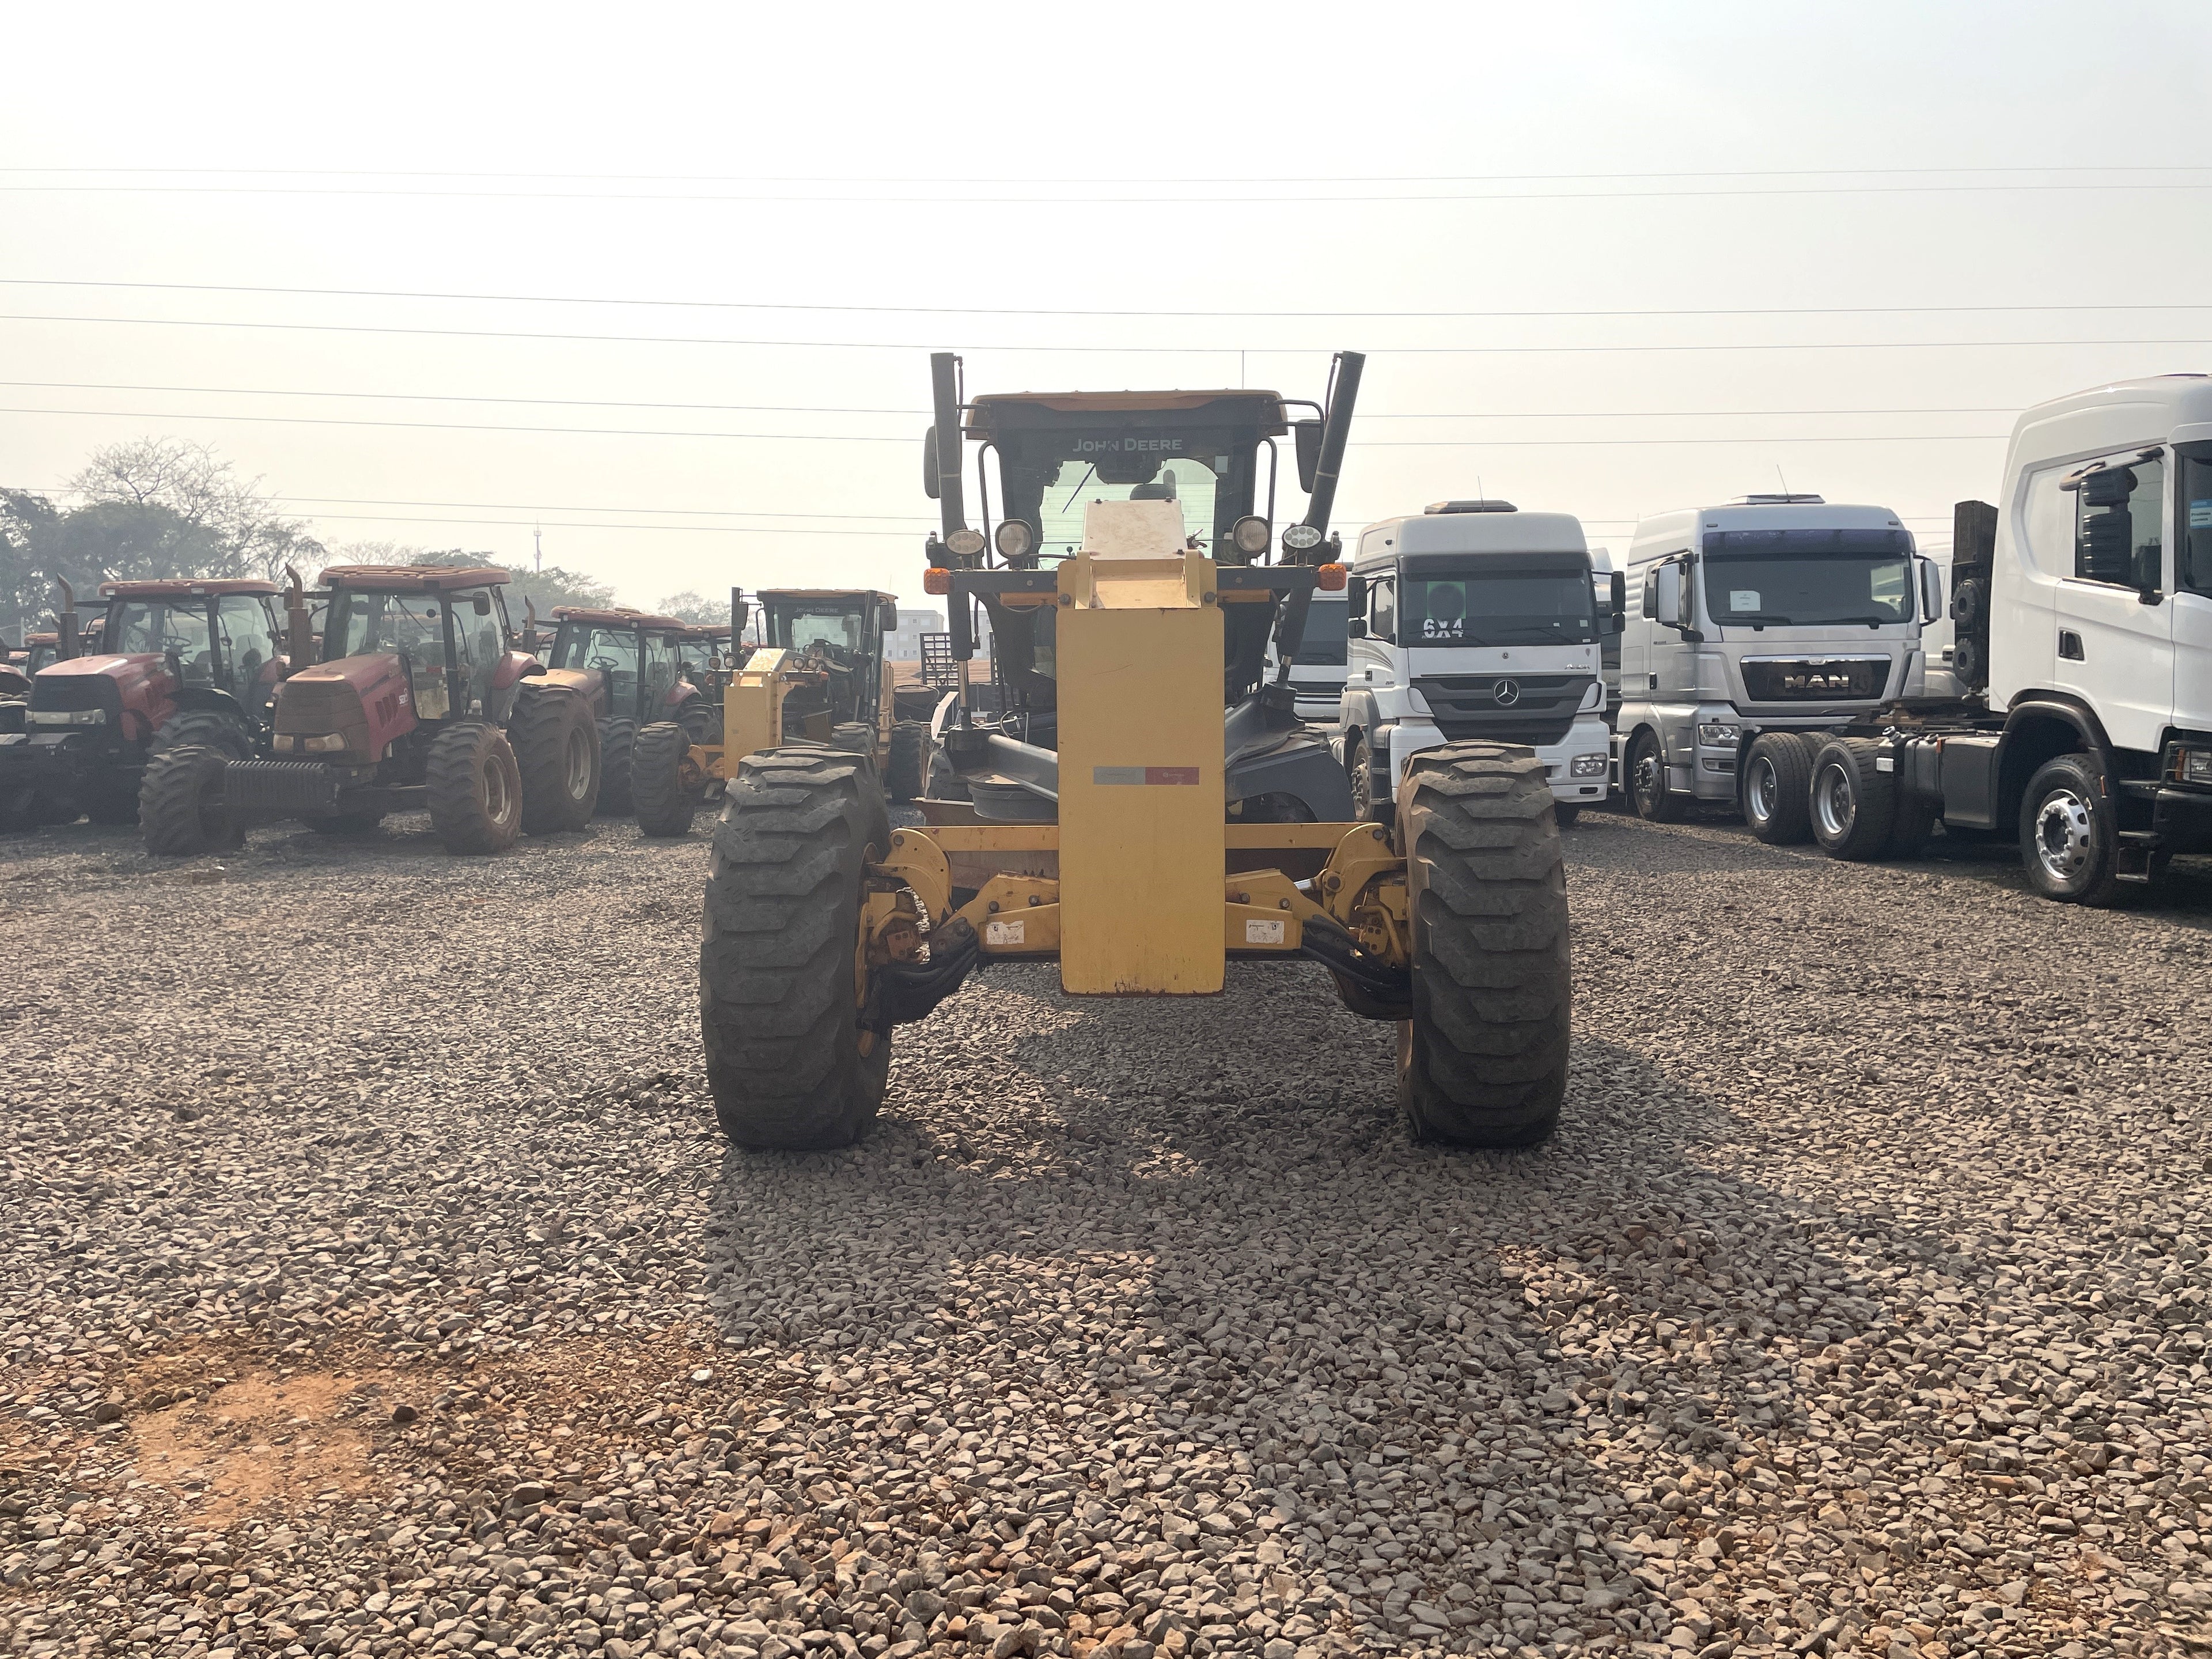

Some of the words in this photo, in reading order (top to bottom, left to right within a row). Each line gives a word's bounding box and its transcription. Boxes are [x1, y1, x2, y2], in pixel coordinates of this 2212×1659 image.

[1073, 439, 1119, 452] JOHN
[1124, 438, 1182, 451] DEERE
[1423, 618, 1464, 638] 6X4
[1785, 675, 1849, 688] MAN
